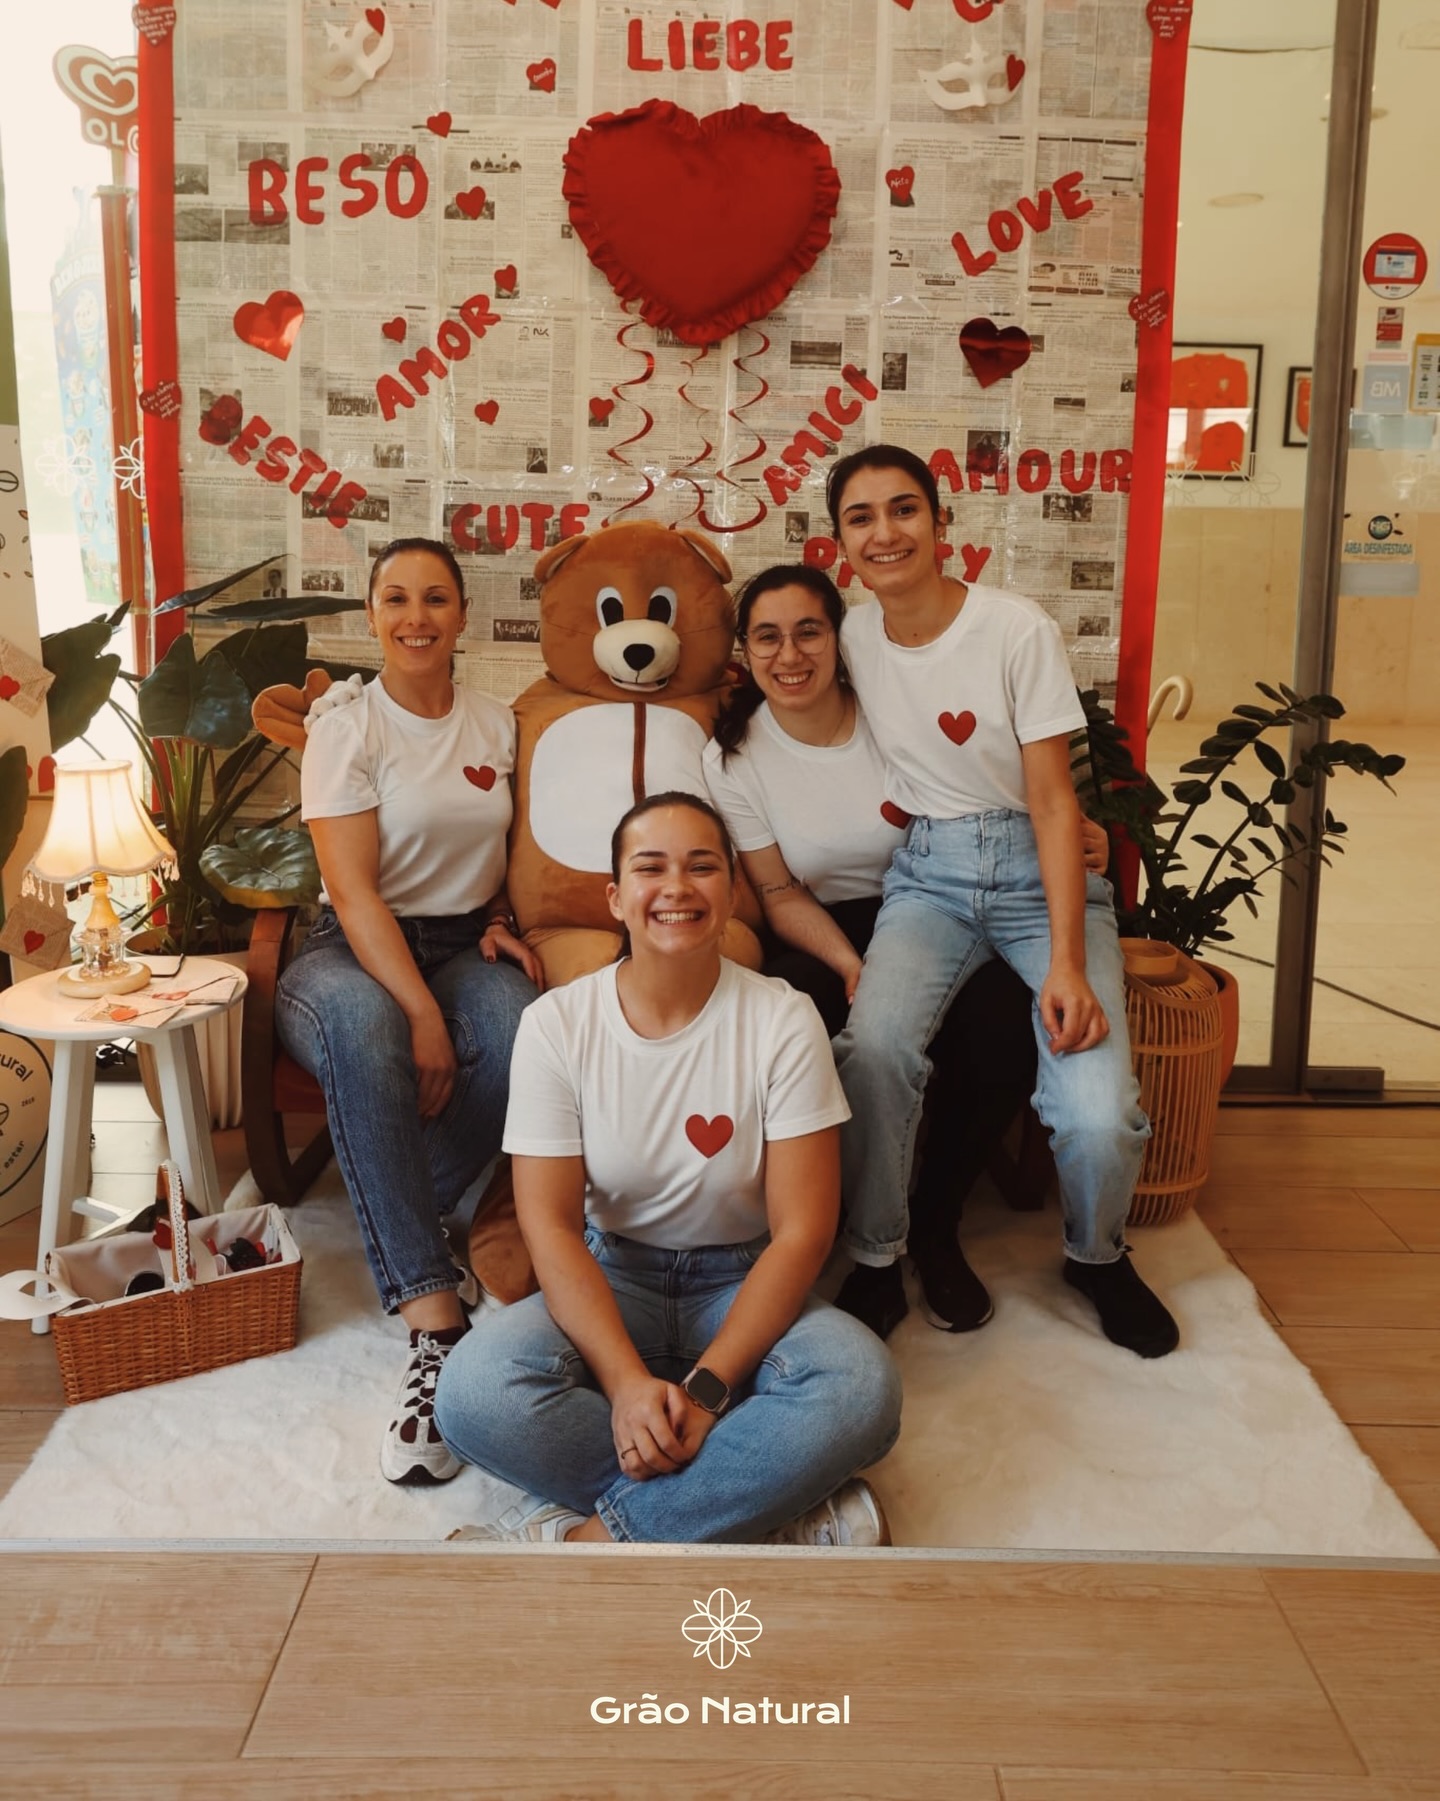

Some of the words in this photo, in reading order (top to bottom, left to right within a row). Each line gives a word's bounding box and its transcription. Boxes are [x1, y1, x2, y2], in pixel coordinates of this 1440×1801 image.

[628, 19, 793, 71] LIEBE
[248, 154, 429, 225] BESO
[951, 171, 1094, 277] LOVE
[376, 293, 502, 421] AMOR
[199, 394, 367, 529] BESTIE
[763, 363, 880, 506] AMICI
[928, 448, 1134, 495] AMOUR
[451, 502, 590, 552] CUTE
[0, 1053, 34, 1082] ural
